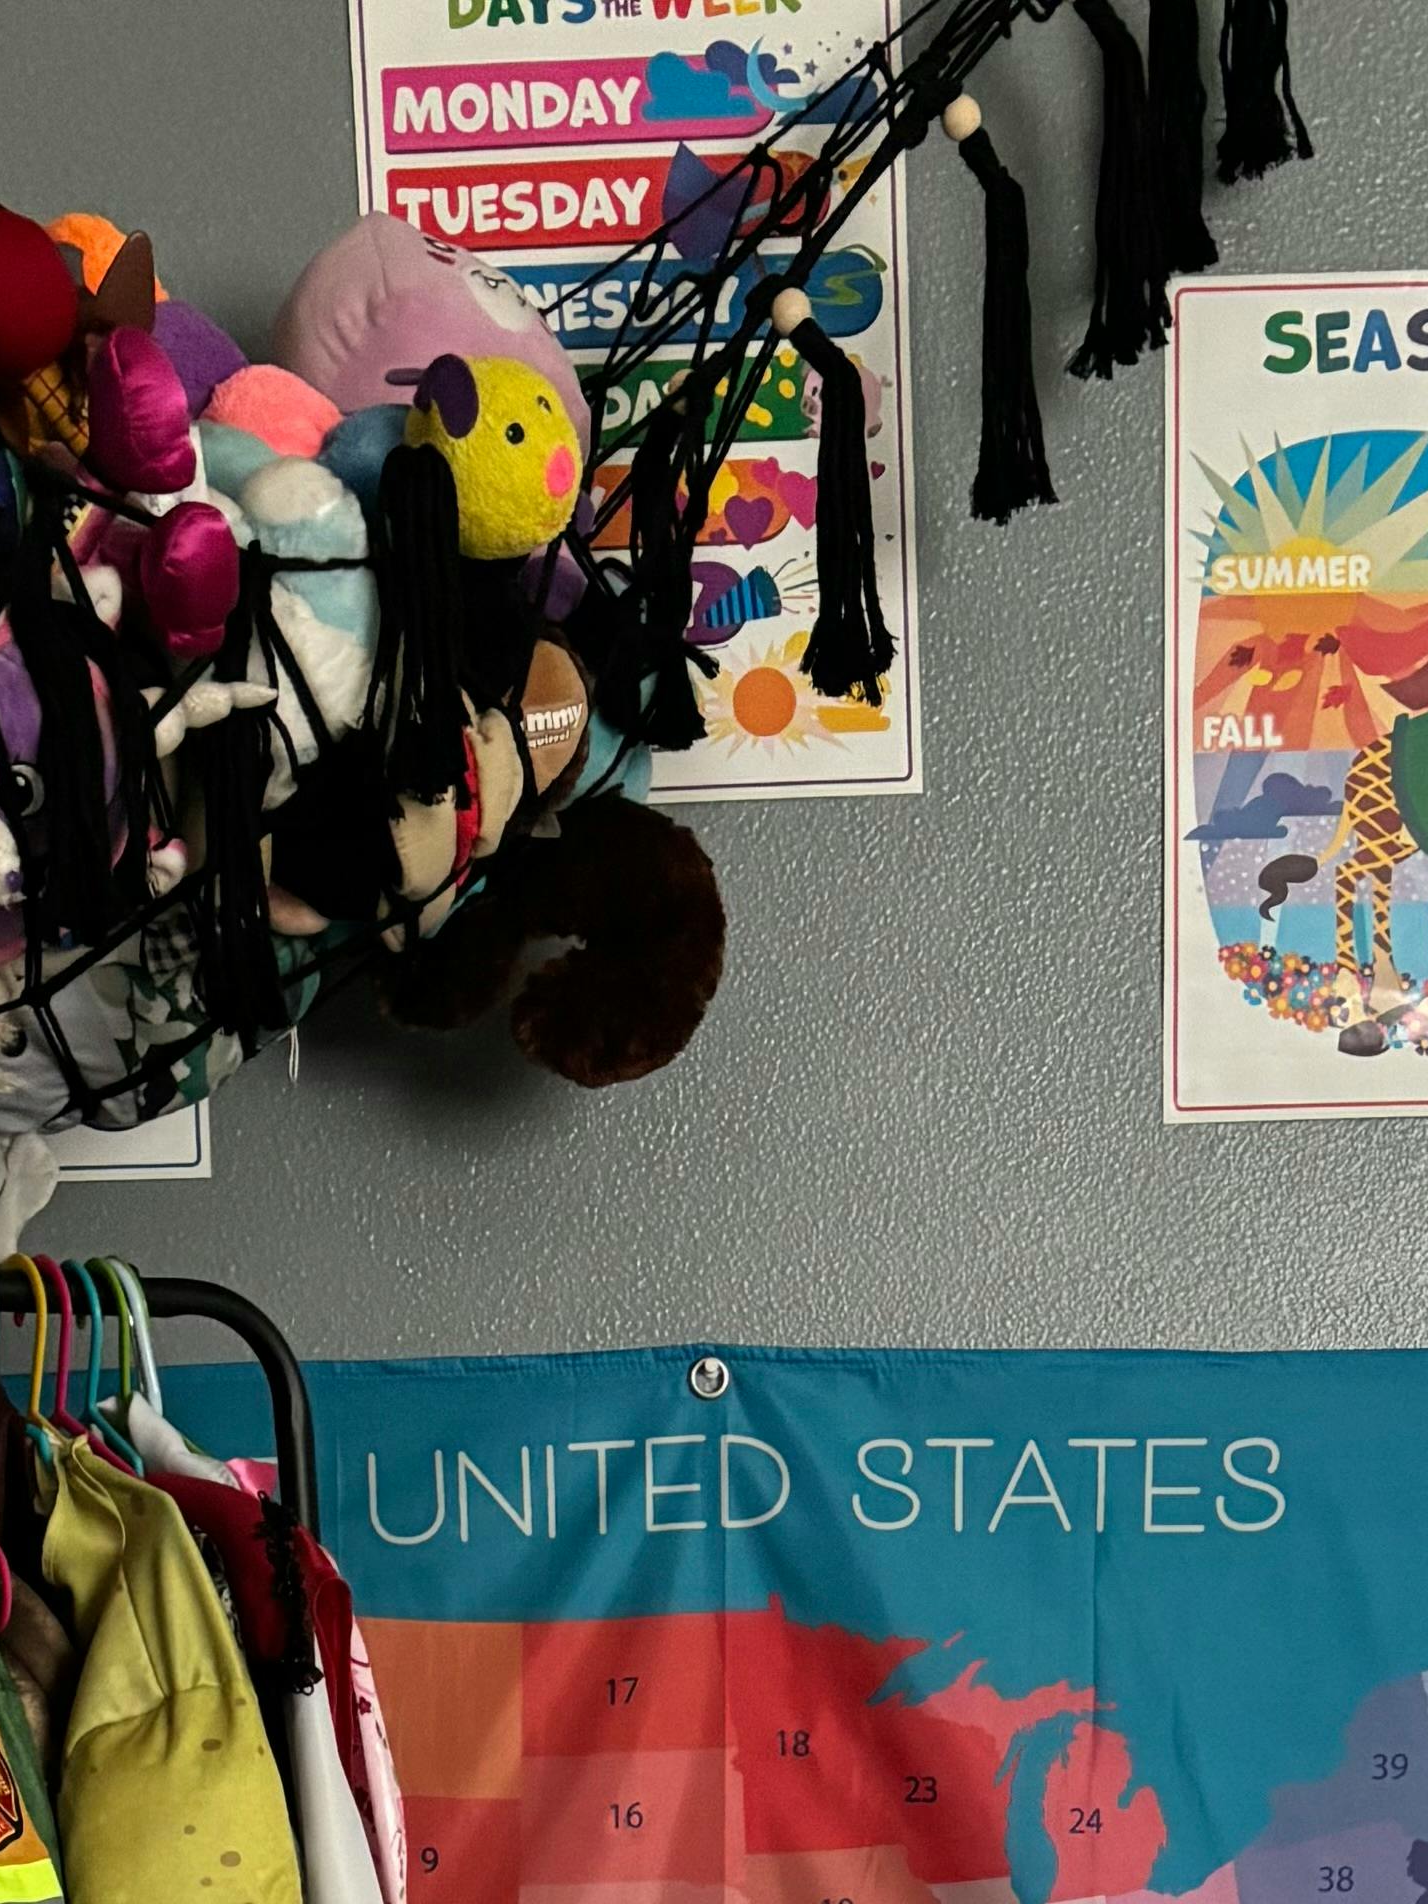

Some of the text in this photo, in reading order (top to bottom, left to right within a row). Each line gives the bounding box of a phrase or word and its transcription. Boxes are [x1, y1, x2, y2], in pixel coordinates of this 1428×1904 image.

[393, 77, 641, 134] MONDAY
[396, 177, 649, 236] TUESDAY
[1212, 554, 1370, 590] SUMMER
[1203, 715, 1282, 749] FALL
[368, 1431, 1287, 1544] UNITED STATES
[607, 1677, 638, 1704] 17
[778, 1730, 810, 1757] 18
[905, 1776, 937, 1803] 23
[1070, 1808, 1102, 1834] 24
[1319, 1866, 1354, 1892] 38
